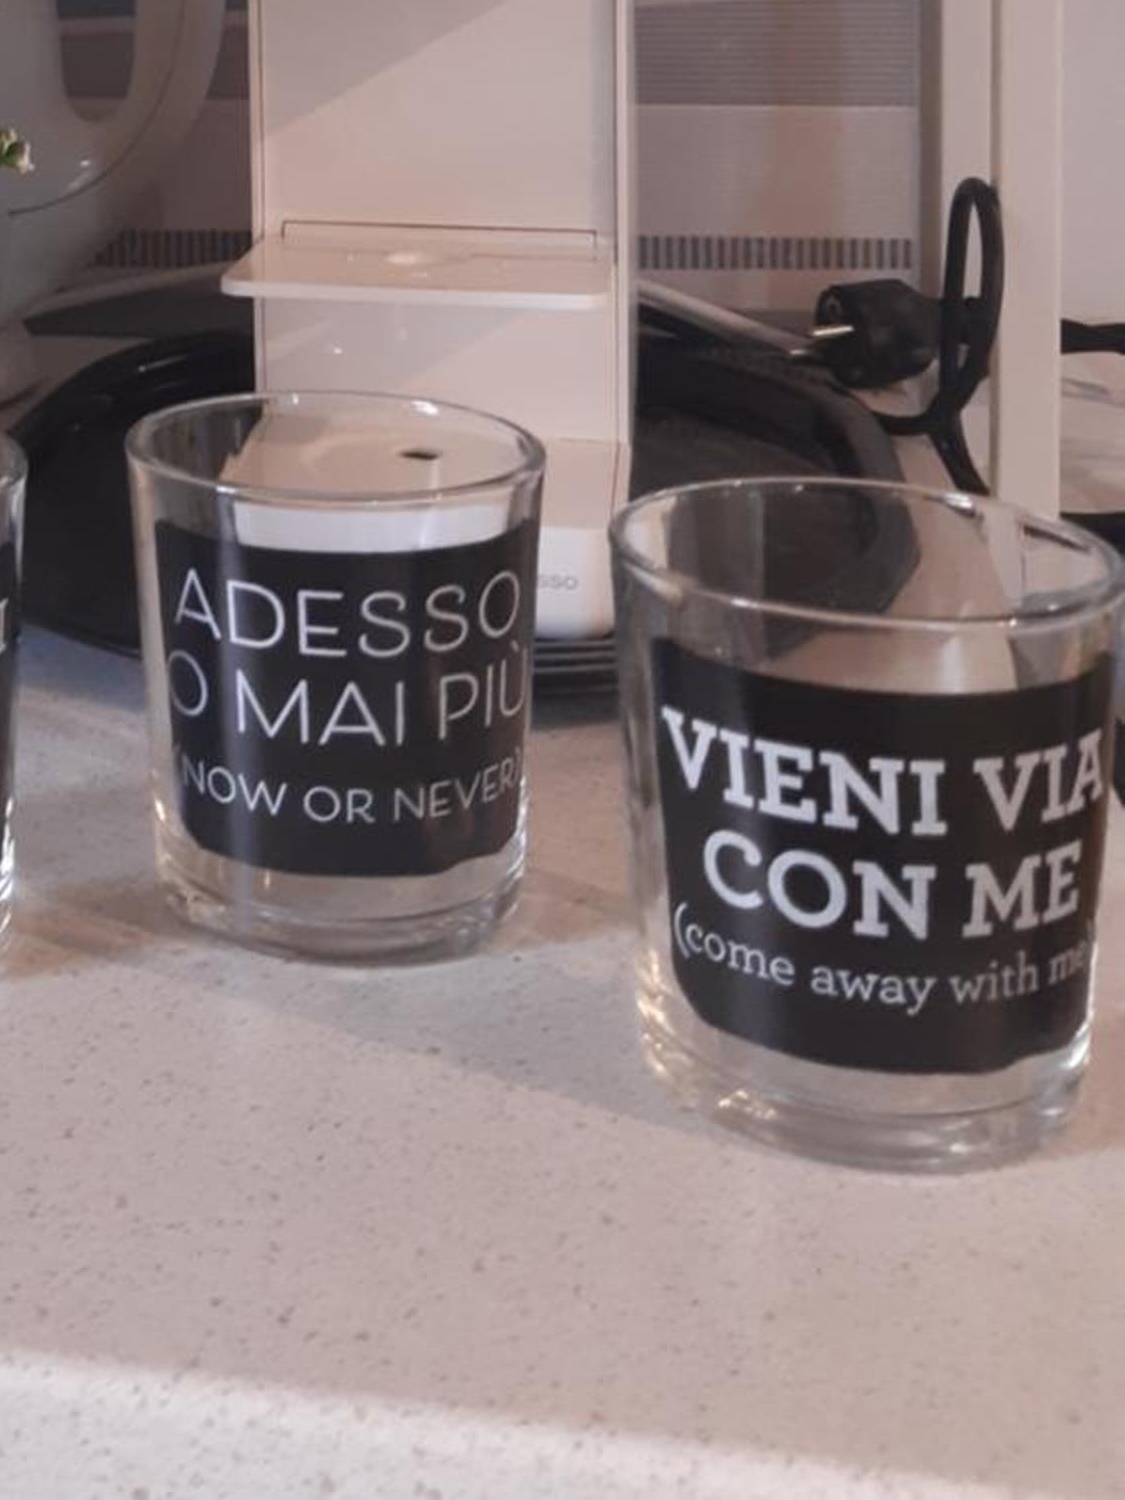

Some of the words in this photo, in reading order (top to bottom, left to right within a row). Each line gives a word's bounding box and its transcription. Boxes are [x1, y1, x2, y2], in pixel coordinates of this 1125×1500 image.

[174, 567, 521, 658] ADESSO
[169, 649, 209, 717] O
[235, 668, 406, 746] MAI
[438, 639, 526, 741] PIÙ
[303, 785, 376, 824] OR
[661, 705, 948, 836] VIENI
[973, 728, 1104, 832] VIA
[703, 829, 937, 940] CON
[962, 840, 1083, 939] ME
[674, 901, 796, 986] (come
[810, 965, 937, 1016] away
[949, 950, 1040, 1003] with
